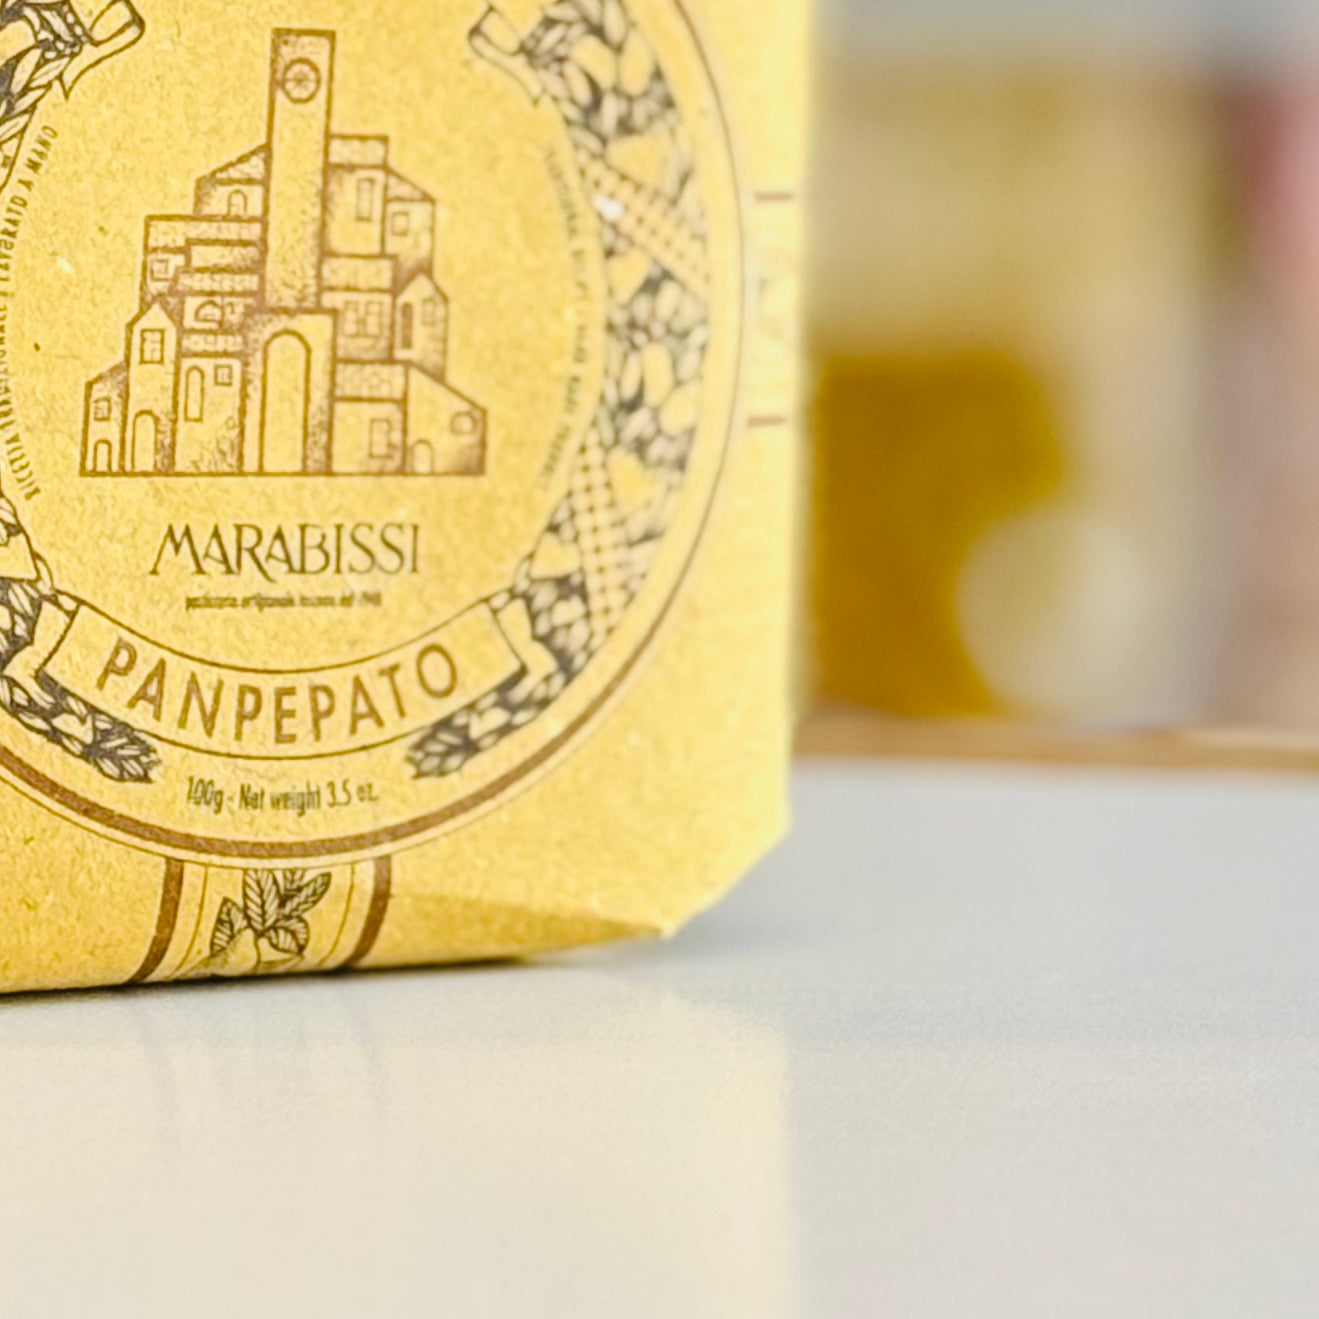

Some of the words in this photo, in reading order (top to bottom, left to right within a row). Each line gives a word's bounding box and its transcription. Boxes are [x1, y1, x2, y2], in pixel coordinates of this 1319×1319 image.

[148, 522, 420, 582] MARABISSI
[95, 636, 458, 745] PANPEPATO
[187, 776, 224, 814] 100g
[238, 782, 265, 810] Net
[269, 781, 321, 816] weight
